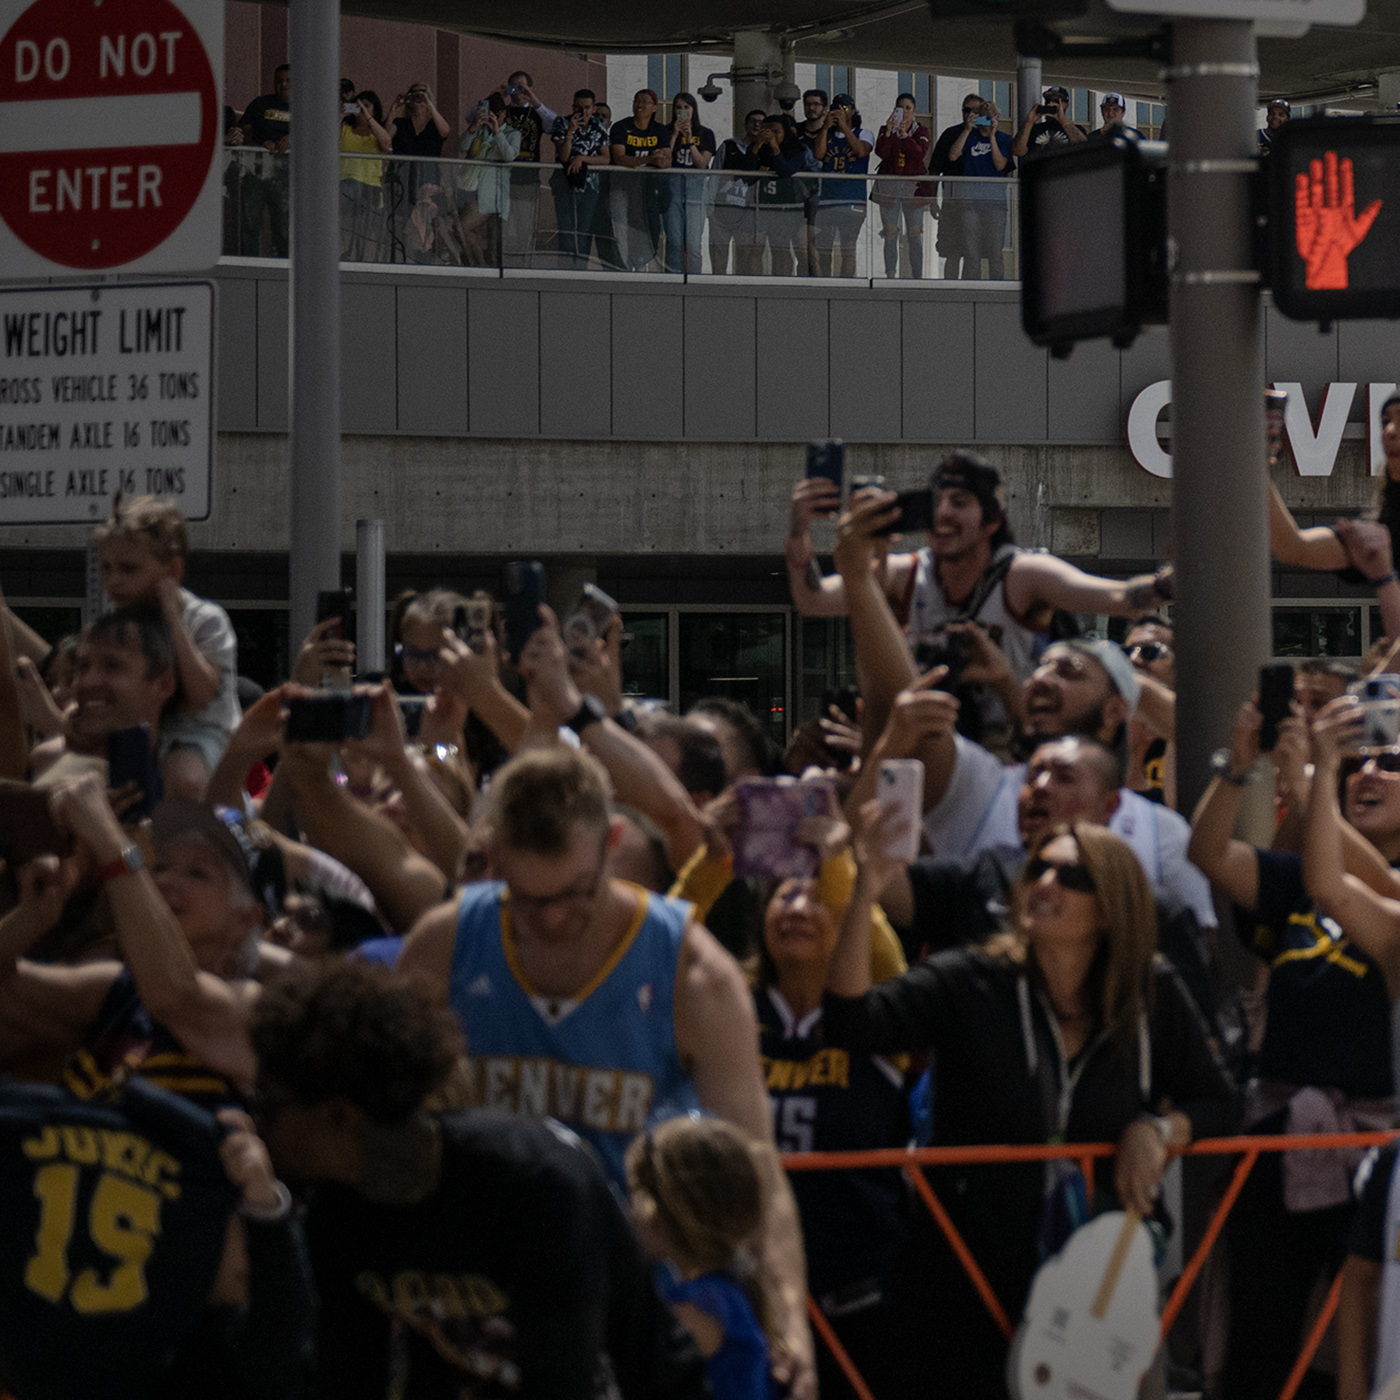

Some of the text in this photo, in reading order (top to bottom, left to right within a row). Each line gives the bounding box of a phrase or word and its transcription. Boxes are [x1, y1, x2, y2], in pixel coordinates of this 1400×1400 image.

[15, 30, 183, 83] DO NOT
[626, 133, 659, 148] DENVER
[833, 156, 845, 170] 15
[28, 164, 163, 213] ENTER
[5, 307, 186, 357] WEIGHT LIMIT
[0, 372, 199, 404] ROSS VEHICLE 36 TONS
[70, 421, 113, 449] AXLE
[124, 421, 140, 448] 16
[151, 419, 191, 447] TONS
[0, 467, 186, 498] SINGLE AXLE 16 TONS
[474, 1056, 656, 1133] ENVER
[774, 1096, 818, 1154] 5
[23, 1163, 164, 1317] 15
